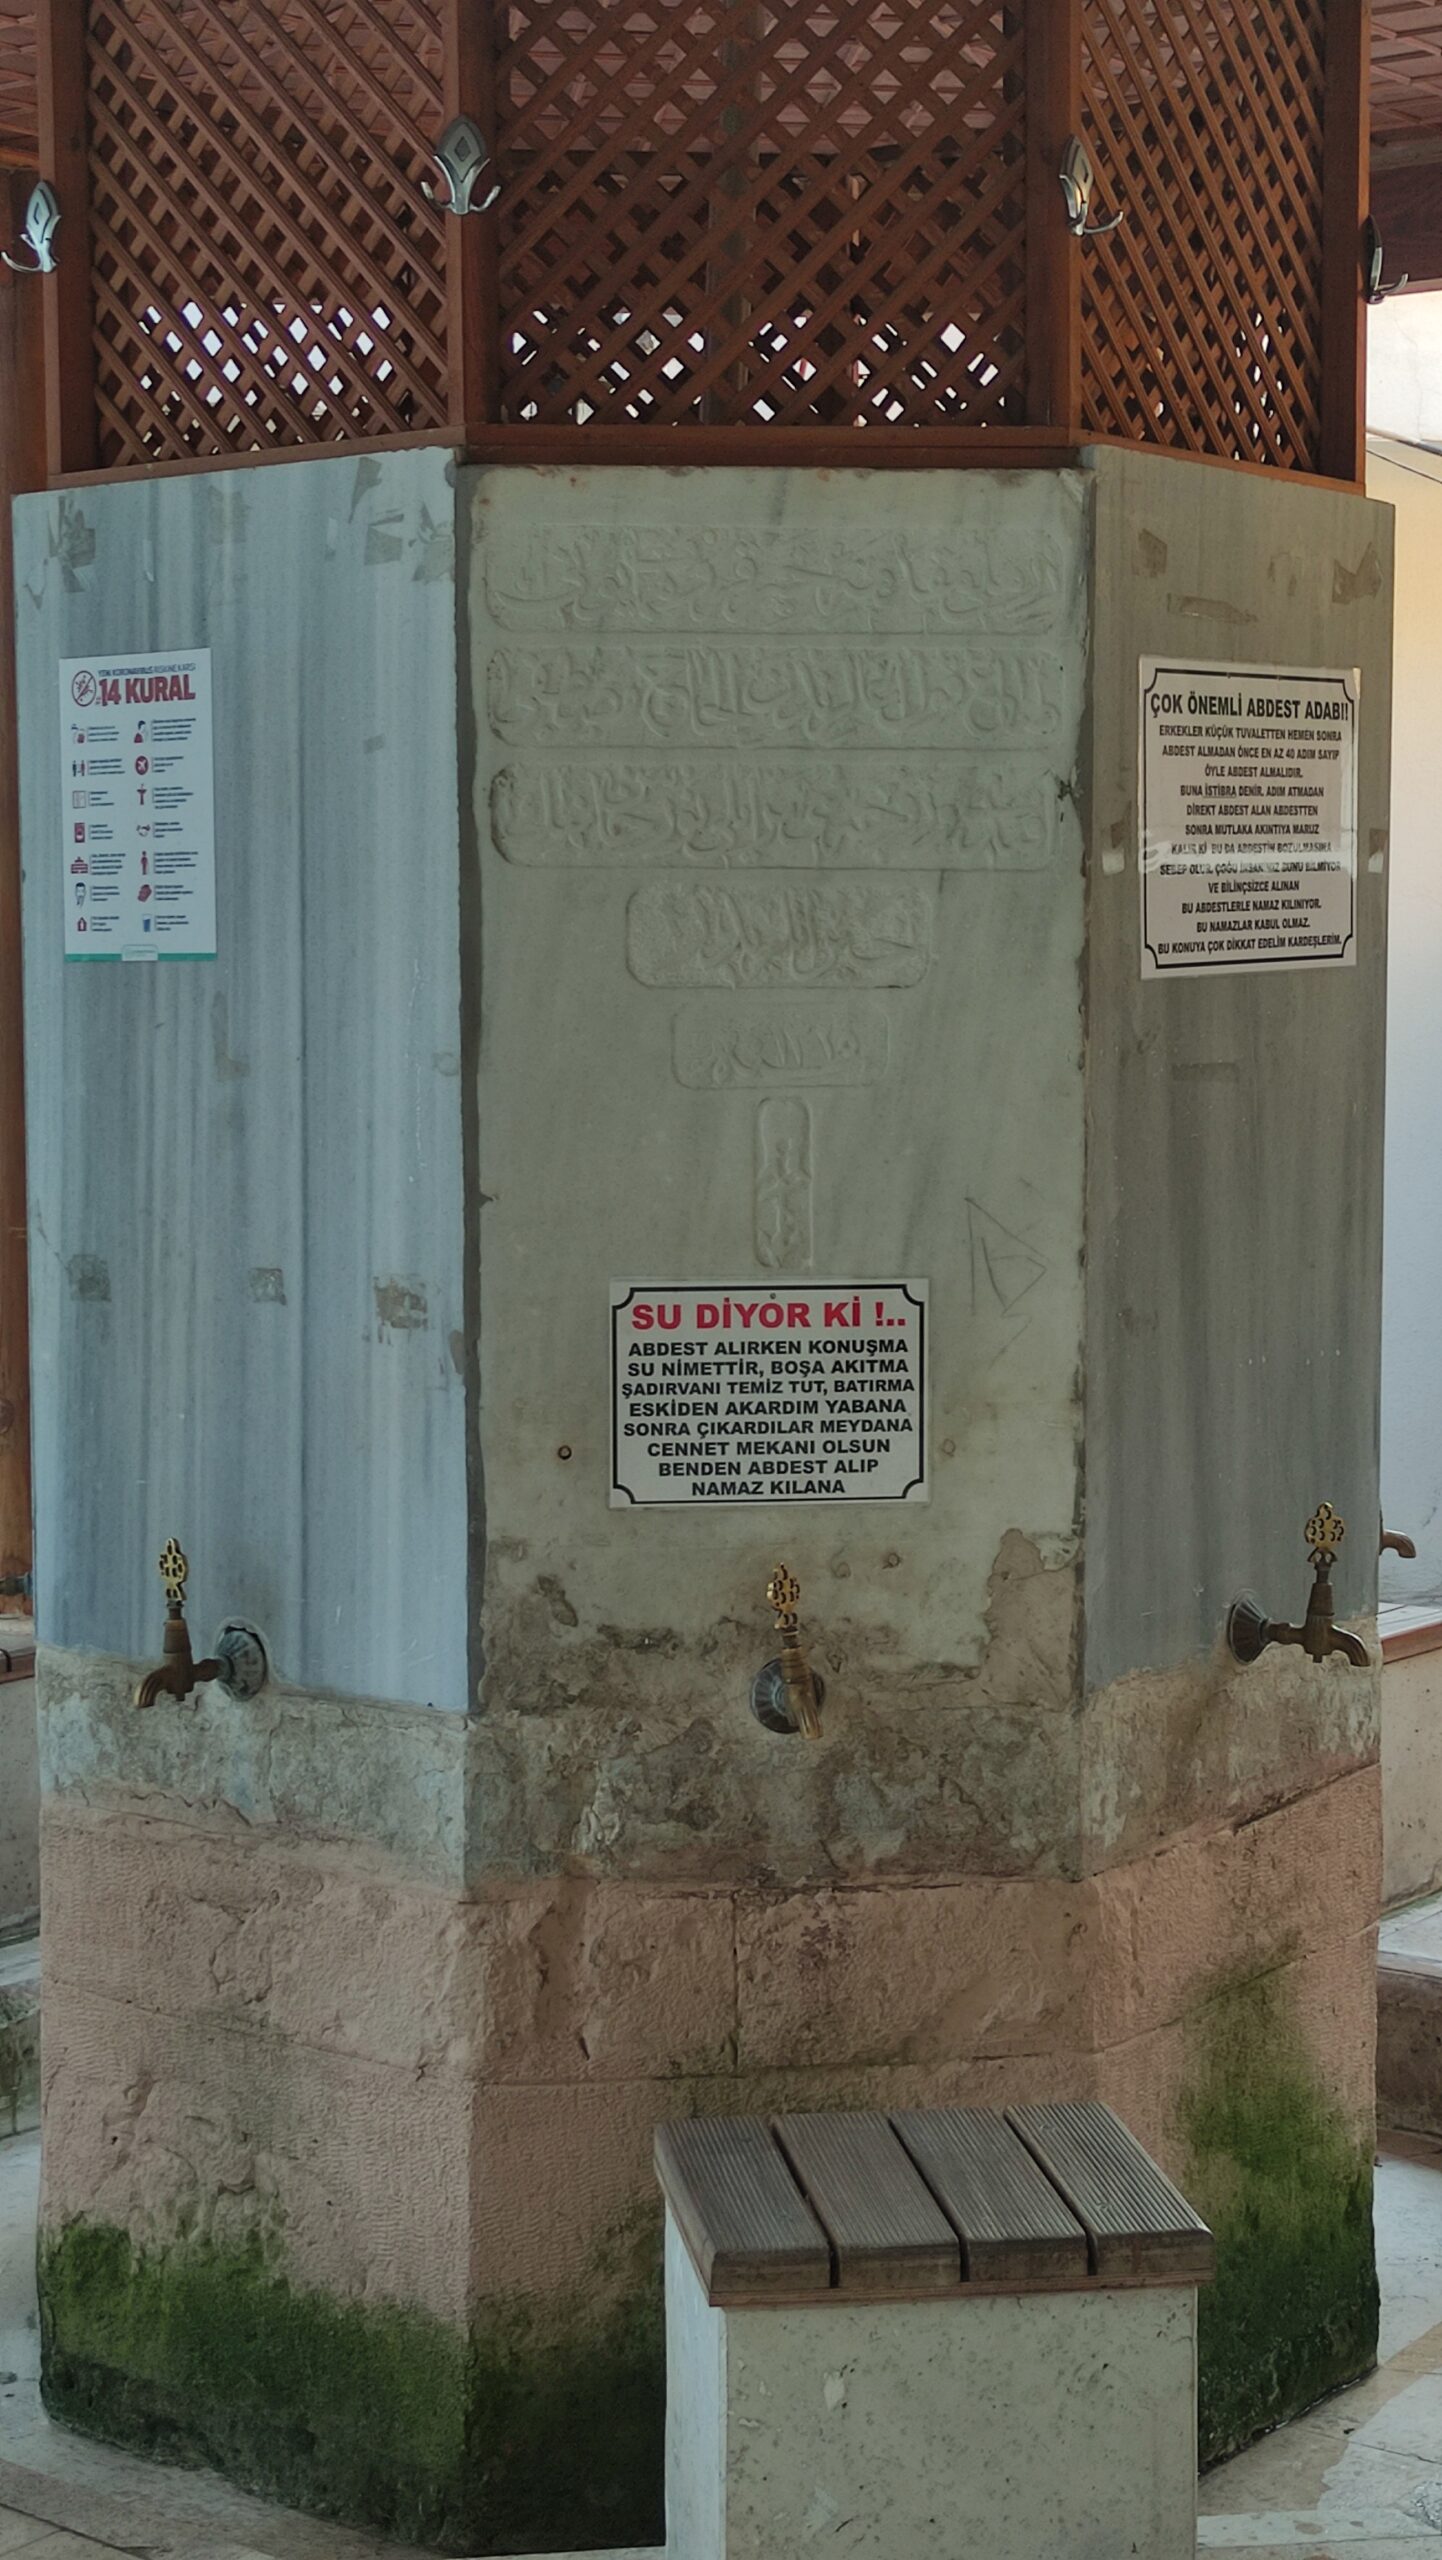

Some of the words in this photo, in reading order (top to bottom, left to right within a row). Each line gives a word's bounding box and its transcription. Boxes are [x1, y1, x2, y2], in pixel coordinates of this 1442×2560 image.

[99, 678, 121, 706] 14
[125, 674, 196, 703] KURAL
[1151, 693, 1183, 718] ÇOK
[1188, 691, 1242, 715] ÖNEMLİ
[1247, 698, 1300, 718] ABDEST
[1159, 725, 1203, 737] ERKEKLER
[1205, 726, 1233, 739] KÜÇÜK
[1236, 727, 1286, 739] TUVALETTEN
[1287, 729, 1314, 740] HEMEN
[1316, 730, 1341, 740] SONRA
[1162, 745, 1195, 757] ABDEST
[1198, 746, 1235, 758] ALMADAN
[1238, 745, 1260, 758] ÖNCE
[1262, 747, 1272, 758] EN
[1274, 748, 1284, 758] AZ
[1286, 749, 1295, 758] 40
[1297, 749, 1316, 759] ADIM
[1318, 749, 1339, 759] SAYIP
[1204, 764, 1226, 777] ÖYLE
[1227, 766, 1258, 777] ABDEST
[1260, 767, 1303, 778] ALMALIDIR.
[1180, 785, 1203, 796] BUNA
[1204, 783, 1237, 797] İSTİBRA
[1239, 784, 1264, 796] DENİR.
[1266, 786, 1286, 796] ADIM
[1288, 786, 1324, 797] ATMADAN
[1187, 802, 1216, 816] DİREKT
[1218, 805, 1249, 816] ABDEST
[1251, 805, 1271, 816] ALAN
[1273, 805, 1318, 816] ABDESTTEN
[1185, 824, 1212, 835] SONRA
[1215, 824, 1252, 835] MUTLAKA
[1255, 824, 1290, 835] AKINTIYA
[1292, 824, 1319, 834] MARUZ
[1225, 843, 1235, 853] DA
[1215, 861, 1237, 876] ÇOĞU
[1208, 883, 1219, 893] VE
[1221, 881, 1269, 895] BİLİNÇSİZCE
[1271, 881, 1299, 891] ALINAN
[1182, 903, 1193, 913] BU
[1195, 901, 1250, 913] ABDESTLERLE
[1252, 900, 1279, 912] NAMAZ
[1281, 898, 1321, 910] KILINIYOR.
[1197, 922, 1207, 933] BU
[1209, 921, 1252, 932] NAMAZLAR
[1254, 919, 1280, 929] KABUL
[1282, 918, 1310, 928] OLMAZ.
[1158, 943, 1169, 954] BU
[1172, 942, 1206, 954] KONUYA
[1208, 940, 1225, 954] ÇOK
[1226, 936, 1256, 950] DİKKAT
[1258, 934, 1286, 948] EDELİM
[1288, 932, 1341, 948] KARDEŞLERİM.
[631, 1304, 681, 1330] SU
[696, 1297, 812, 1329] DİYOR
[824, 1295, 860, 1327] Kİ
[874, 1301, 906, 1327] !..
[628, 1342, 708, 1356] ABDEST
[714, 1340, 801, 1355] ALIRKEN
[809, 1339, 909, 1357] KONUŞMA
[628, 1363, 655, 1377] SU
[662, 1358, 765, 1378] NİMETTİR,
[771, 1360, 825, 1379] BOŞA
[831, 1359, 909, 1373] AKITMA
[621, 1382, 721, 1397] ŞADIRVANI
[726, 1378, 783, 1393] TEMİZ
[788, 1380, 828, 1395] TUT,
[834, 1379, 915, 1393] BATIRMA
[629, 1399, 719, 1417] ESKİDEN
[725, 1401, 819, 1416] AKARDIM
[825, 1399, 907, 1414] YABANA
[623, 1422, 690, 1436] SONRA
[696, 1420, 814, 1439] ÇIKARDILAR
[819, 1419, 913, 1434] MEYDANA
[647, 1442, 730, 1457] CENNET
[737, 1441, 816, 1455] MEKANI
[822, 1439, 891, 1453] OLSUN
[658, 1461, 741, 1477] BENDEN
[748, 1460, 828, 1475] ABDEST
[834, 1459, 879, 1473] ALIP
[691, 1481, 764, 1496] NAMAZ
[770, 1479, 845, 1494] KILANA
